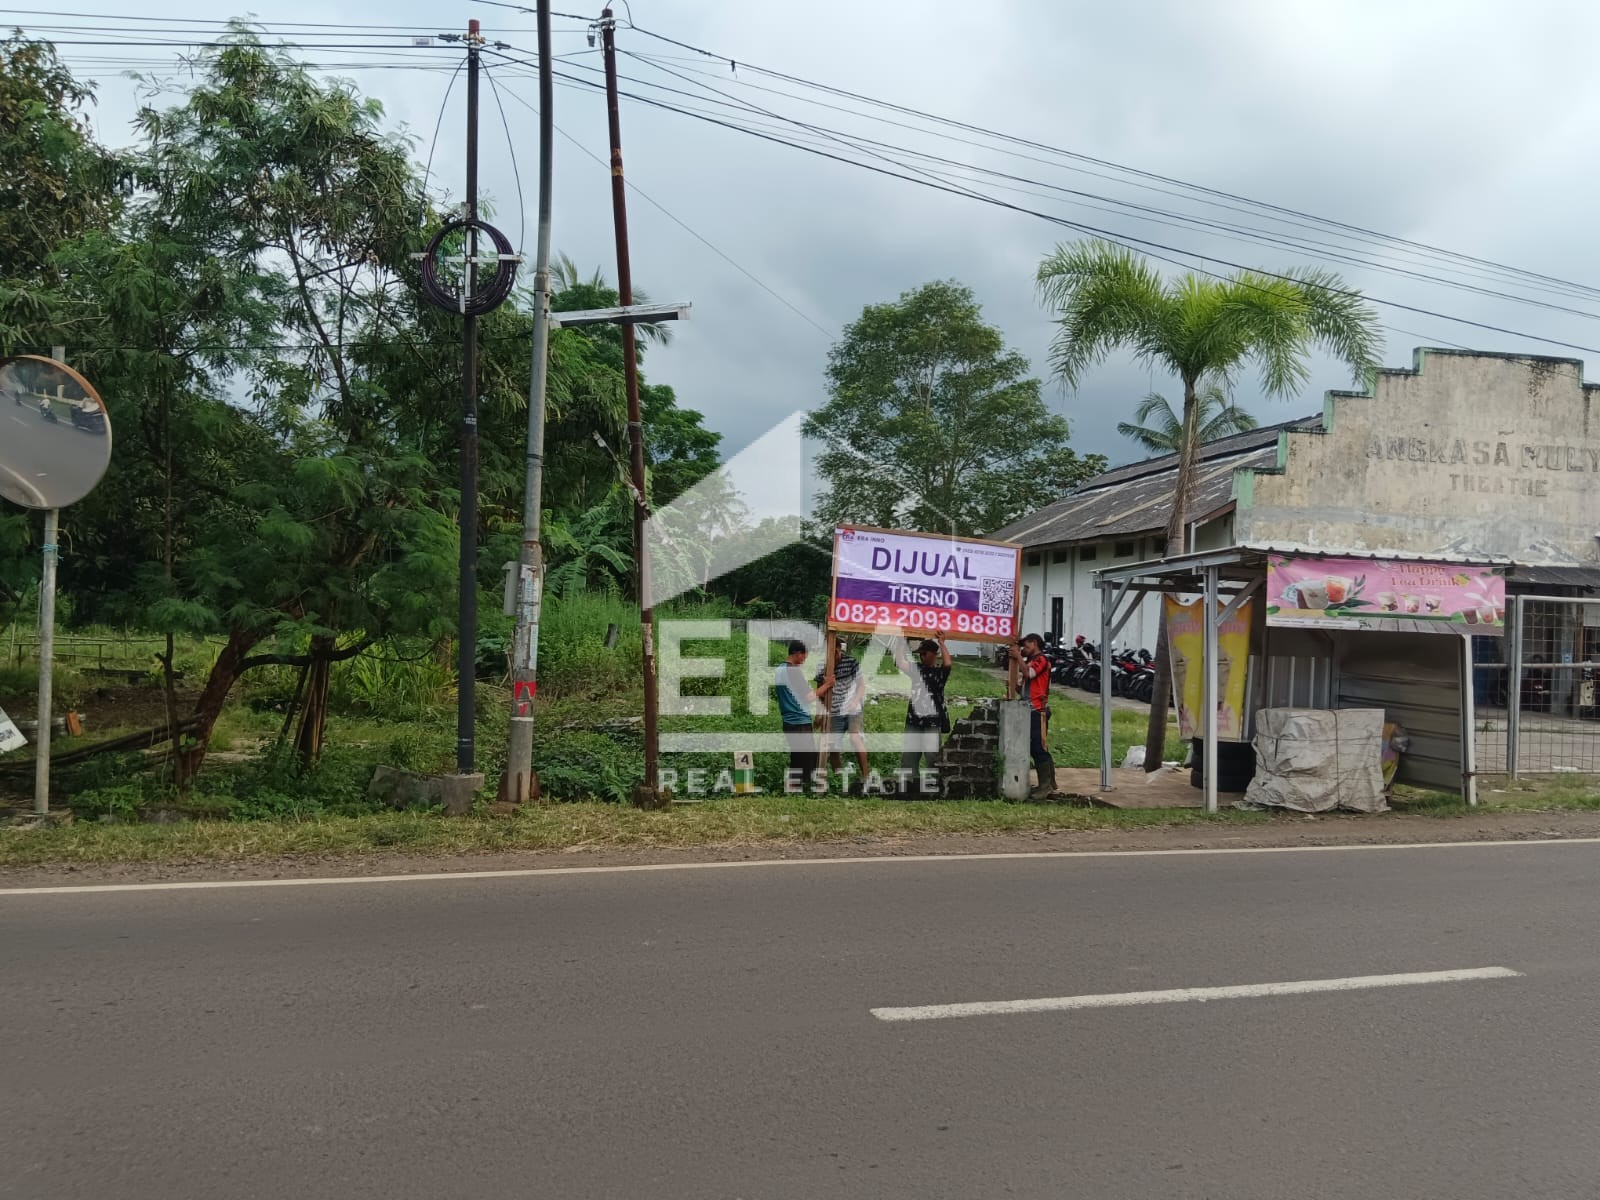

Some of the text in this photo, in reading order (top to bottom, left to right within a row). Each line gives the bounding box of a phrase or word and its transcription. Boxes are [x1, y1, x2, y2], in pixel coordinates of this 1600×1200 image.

[1365, 434, 1510, 467] ANGKASA
[871, 547, 977, 581] DIJUAL
[888, 585, 959, 607] TRISNO
[835, 602, 1012, 636] 0823 2093 9888
[740, 754, 750, 766] 4
